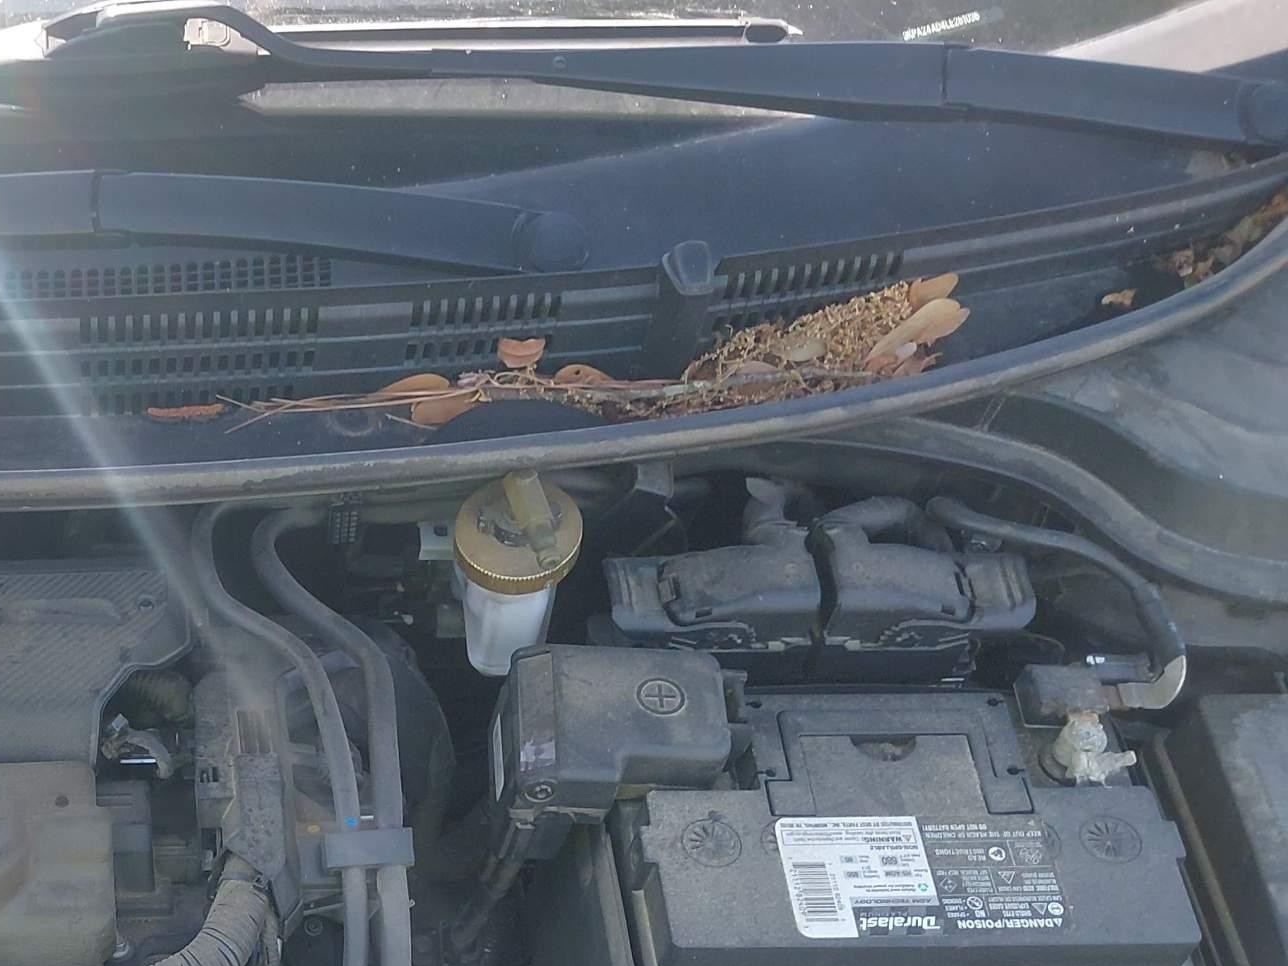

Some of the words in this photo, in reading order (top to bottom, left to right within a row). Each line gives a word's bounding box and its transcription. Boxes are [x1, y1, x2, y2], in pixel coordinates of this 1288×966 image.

[975, 910, 986, 918] NO
[859, 916, 940, 930] Duralast
[957, 918, 1054, 929] DANGER/POISON
